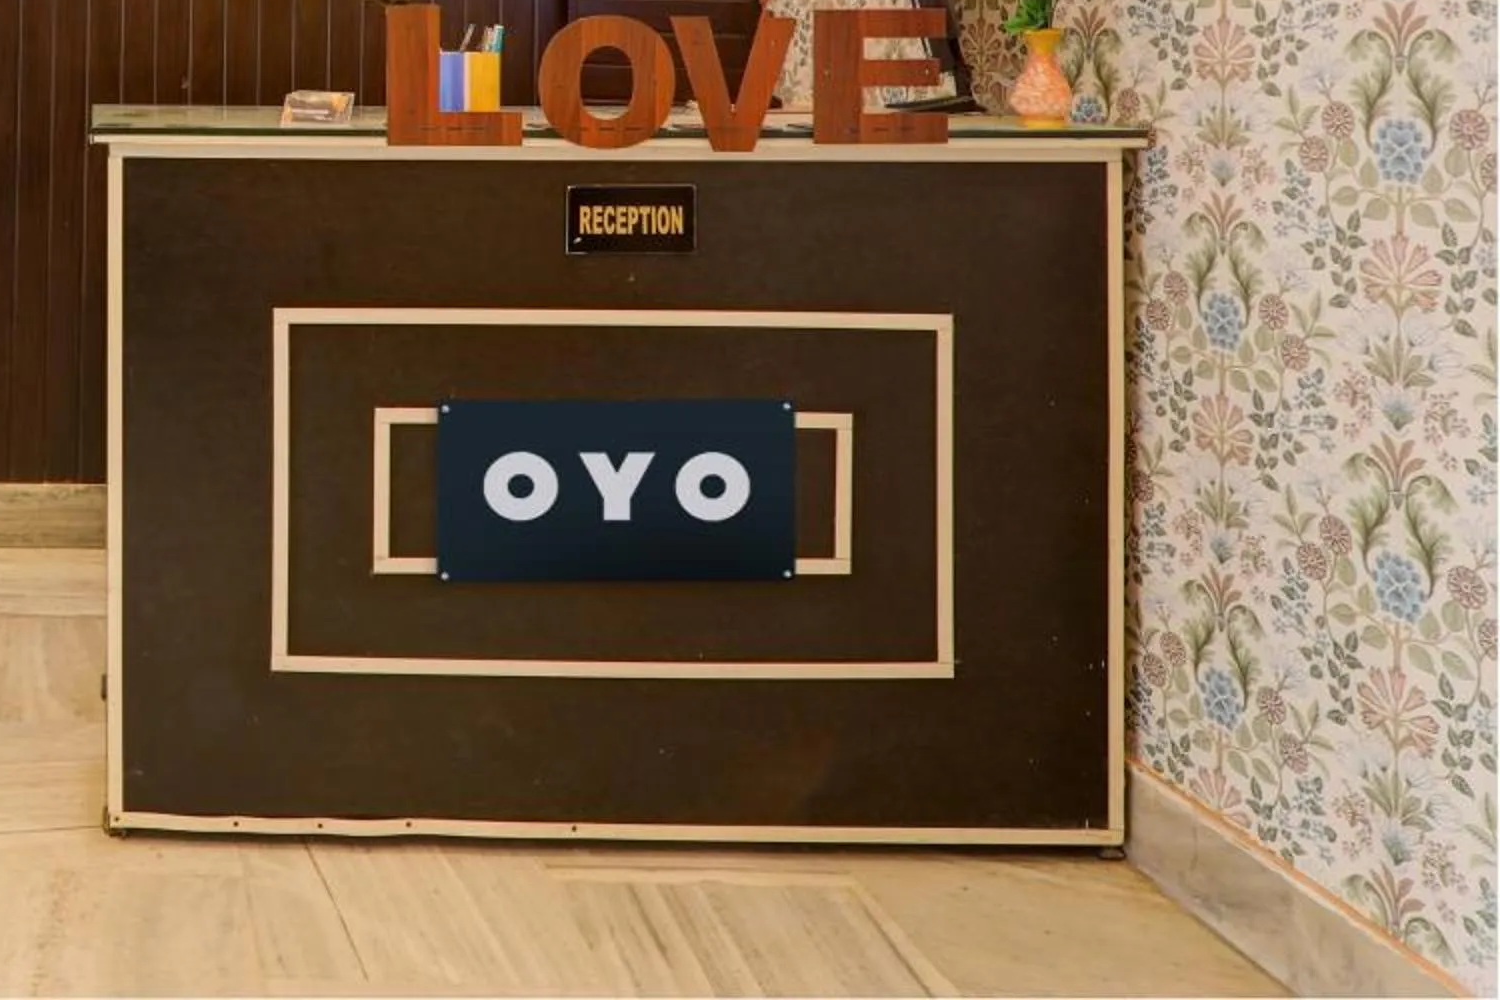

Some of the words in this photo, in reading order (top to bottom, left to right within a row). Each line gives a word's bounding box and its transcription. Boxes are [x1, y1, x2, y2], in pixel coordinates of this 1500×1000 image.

[386, 3, 948, 152] LOVE
[579, 205, 684, 235] RECEPTION
[483, 451, 751, 521] OYO
